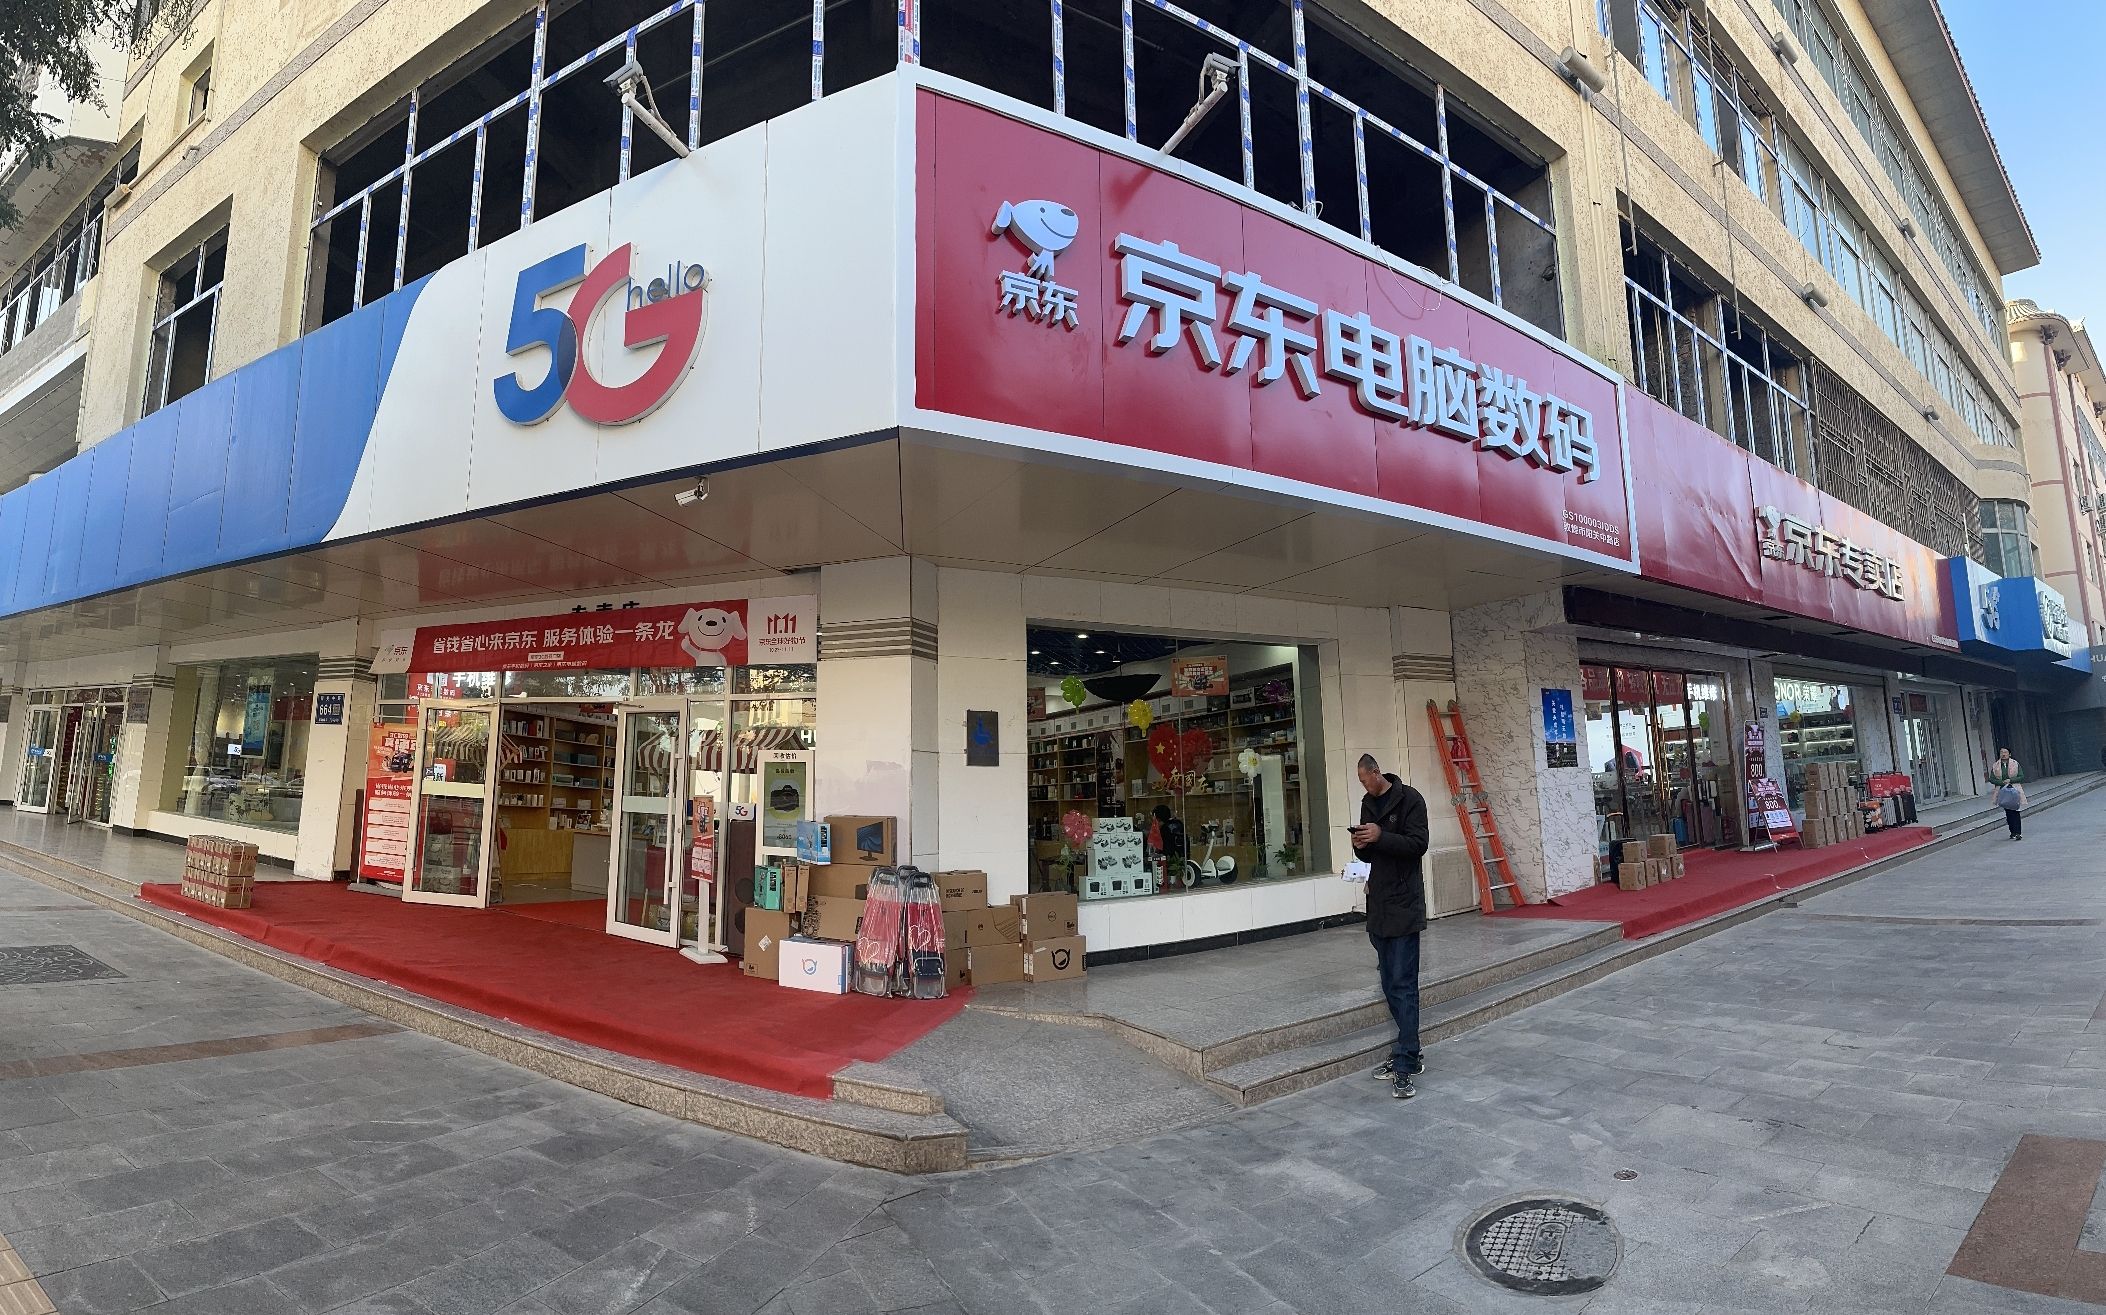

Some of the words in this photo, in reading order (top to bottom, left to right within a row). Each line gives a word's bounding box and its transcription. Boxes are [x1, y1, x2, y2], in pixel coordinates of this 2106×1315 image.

[627, 260, 709, 312] hello
[998, 269, 1080, 330] 京东
[494, 242, 708, 426] 5G
[1115, 232, 1600, 484] 京东电脑数码
[1784, 512, 1905, 602] 京东专卖店
[433, 630, 537, 654] 省钱省心来京东
[543, 620, 676, 648] 服务体验一条龙
